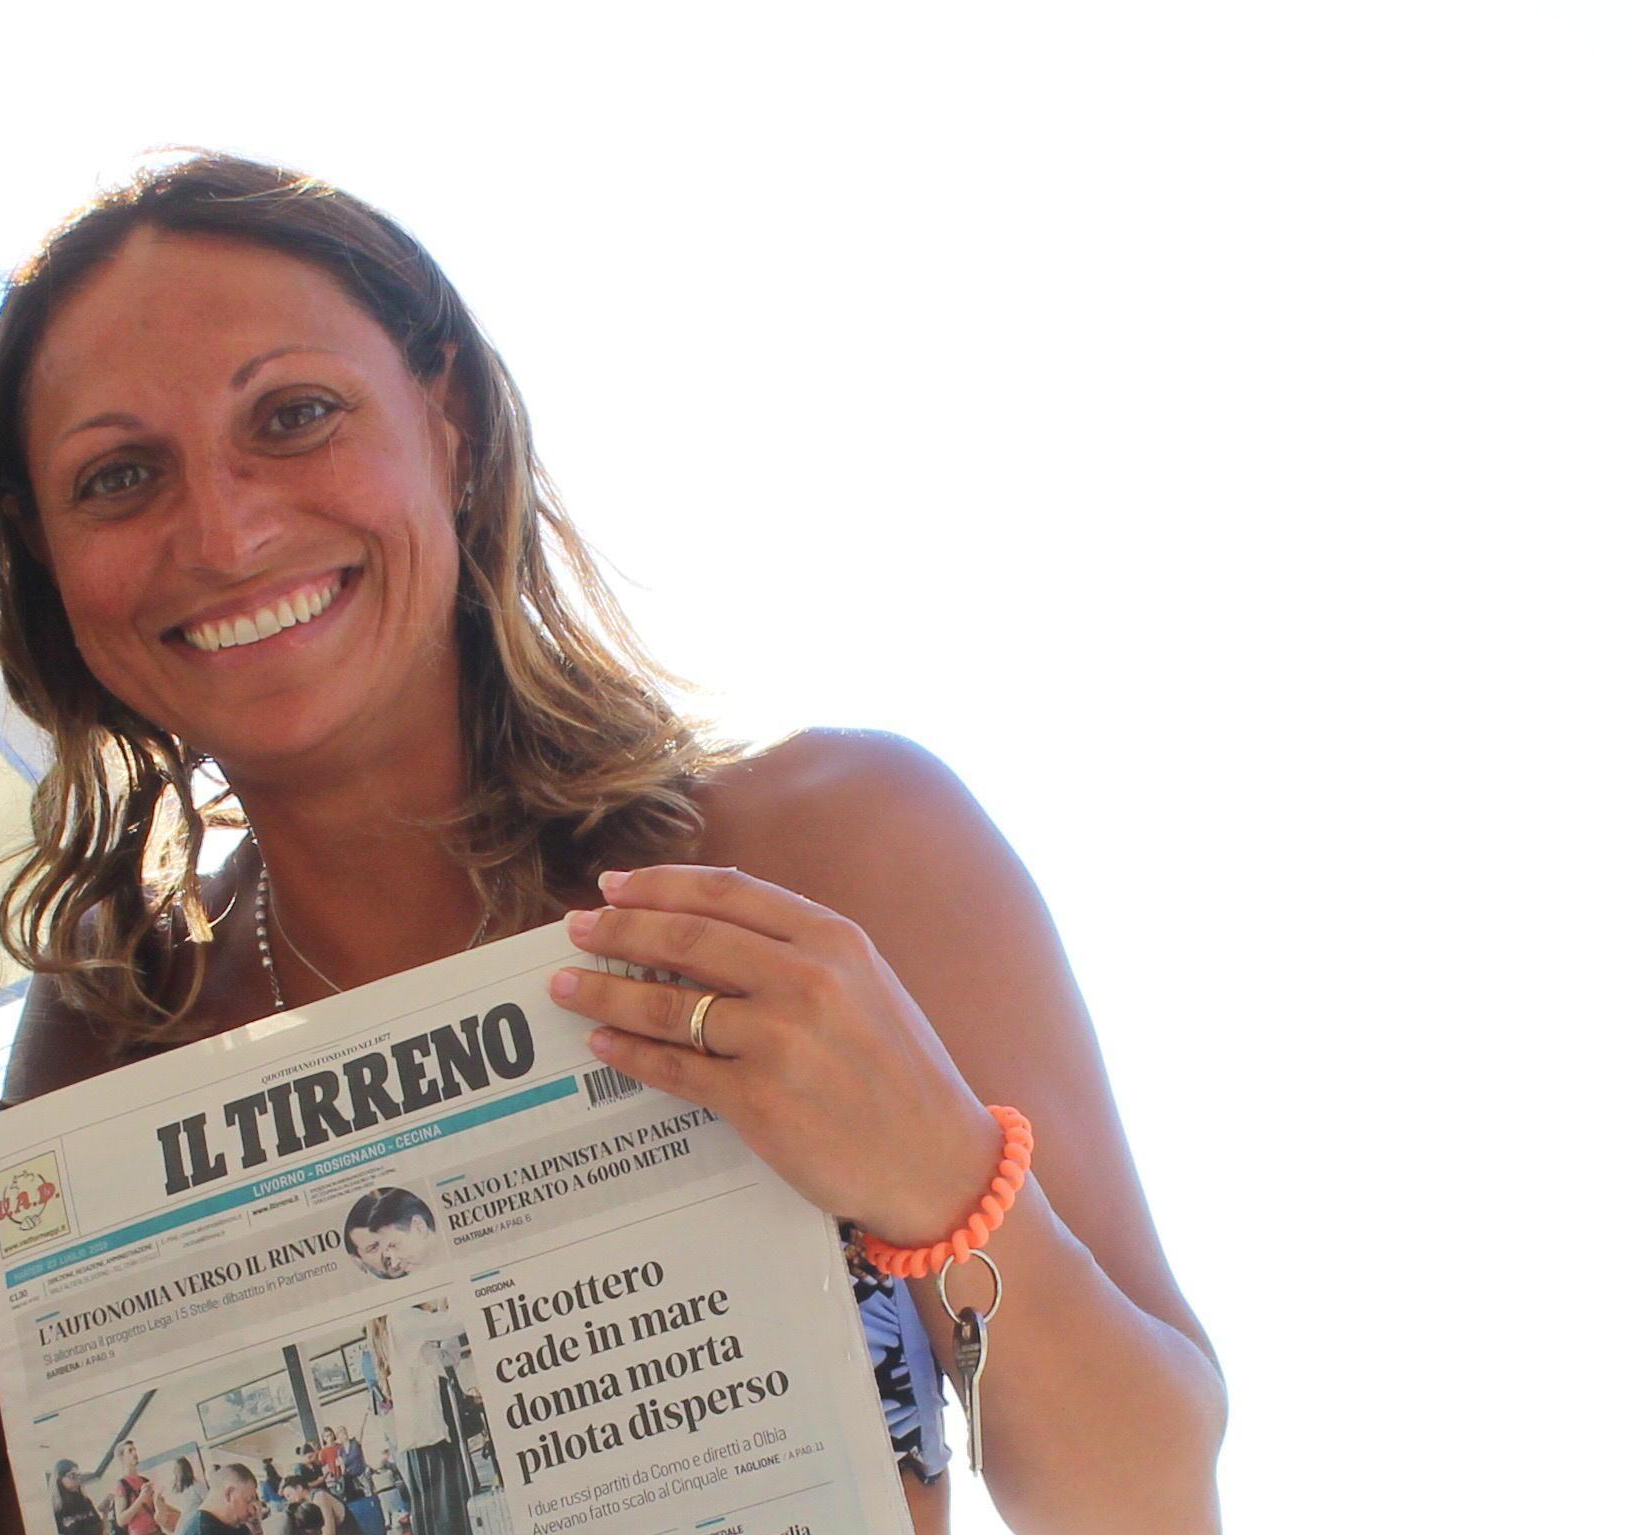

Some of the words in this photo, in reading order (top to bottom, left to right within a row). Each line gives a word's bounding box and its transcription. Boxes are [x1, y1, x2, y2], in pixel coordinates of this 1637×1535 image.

[156, 1112, 229, 1197] IL
[223, 1002, 535, 1170] TIRRENO
[252, 1169, 306, 1198] LIVORNO
[314, 1142, 386, 1176] ROSIGNANO
[395, 1124, 442, 1149] CECINA
[441, 1177, 501, 1209] SALVO
[502, 1141, 613, 1189] L'ALPINISTA
[613, 1135, 635, 1153] IN
[636, 1106, 715, 1145] PAKISTA
[448, 1179, 569, 1231] RECUPERATO
[573, 1174, 585, 1191] A
[586, 1158, 631, 1185] 6000
[633, 1137, 690, 1169] METRI
[453, 1226, 494, 1246] CHATRIAN
[39, 1285, 173, 1347] L'AUTONOMIA
[173, 1262, 242, 1298] VERSO
[245, 1255, 267, 1276] IL
[267, 1229, 342, 1269] RINVIO
[474, 1277, 516, 1298] GORGONA
[481, 1261, 664, 1340] Elicottero
[44, 1361, 81, 1379] BARBERA
[495, 1333, 580, 1384] cade
[584, 1320, 626, 1356] in
[628, 1289, 729, 1342] mare
[506, 1373, 623, 1430] donna
[625, 1335, 744, 1393] morta
[516, 1422, 624, 1486] pilota
[628, 1370, 789, 1441] disperso
[534, 1499, 559, 1517] due
[560, 1485, 592, 1508] russi
[593, 1473, 631, 1501] partiti
[632, 1469, 650, 1486] da
[650, 1458, 691, 1480] Como
[702, 1438, 741, 1464] diretti
[752, 1427, 788, 1448] Olbia
[733, 1453, 781, 1476] TAGLIONE
[588, 1501, 621, 1521] fatto
[621, 1488, 657, 1511] scalo
[658, 1481, 671, 1500] al
[671, 1466, 729, 1495] Cinquale
